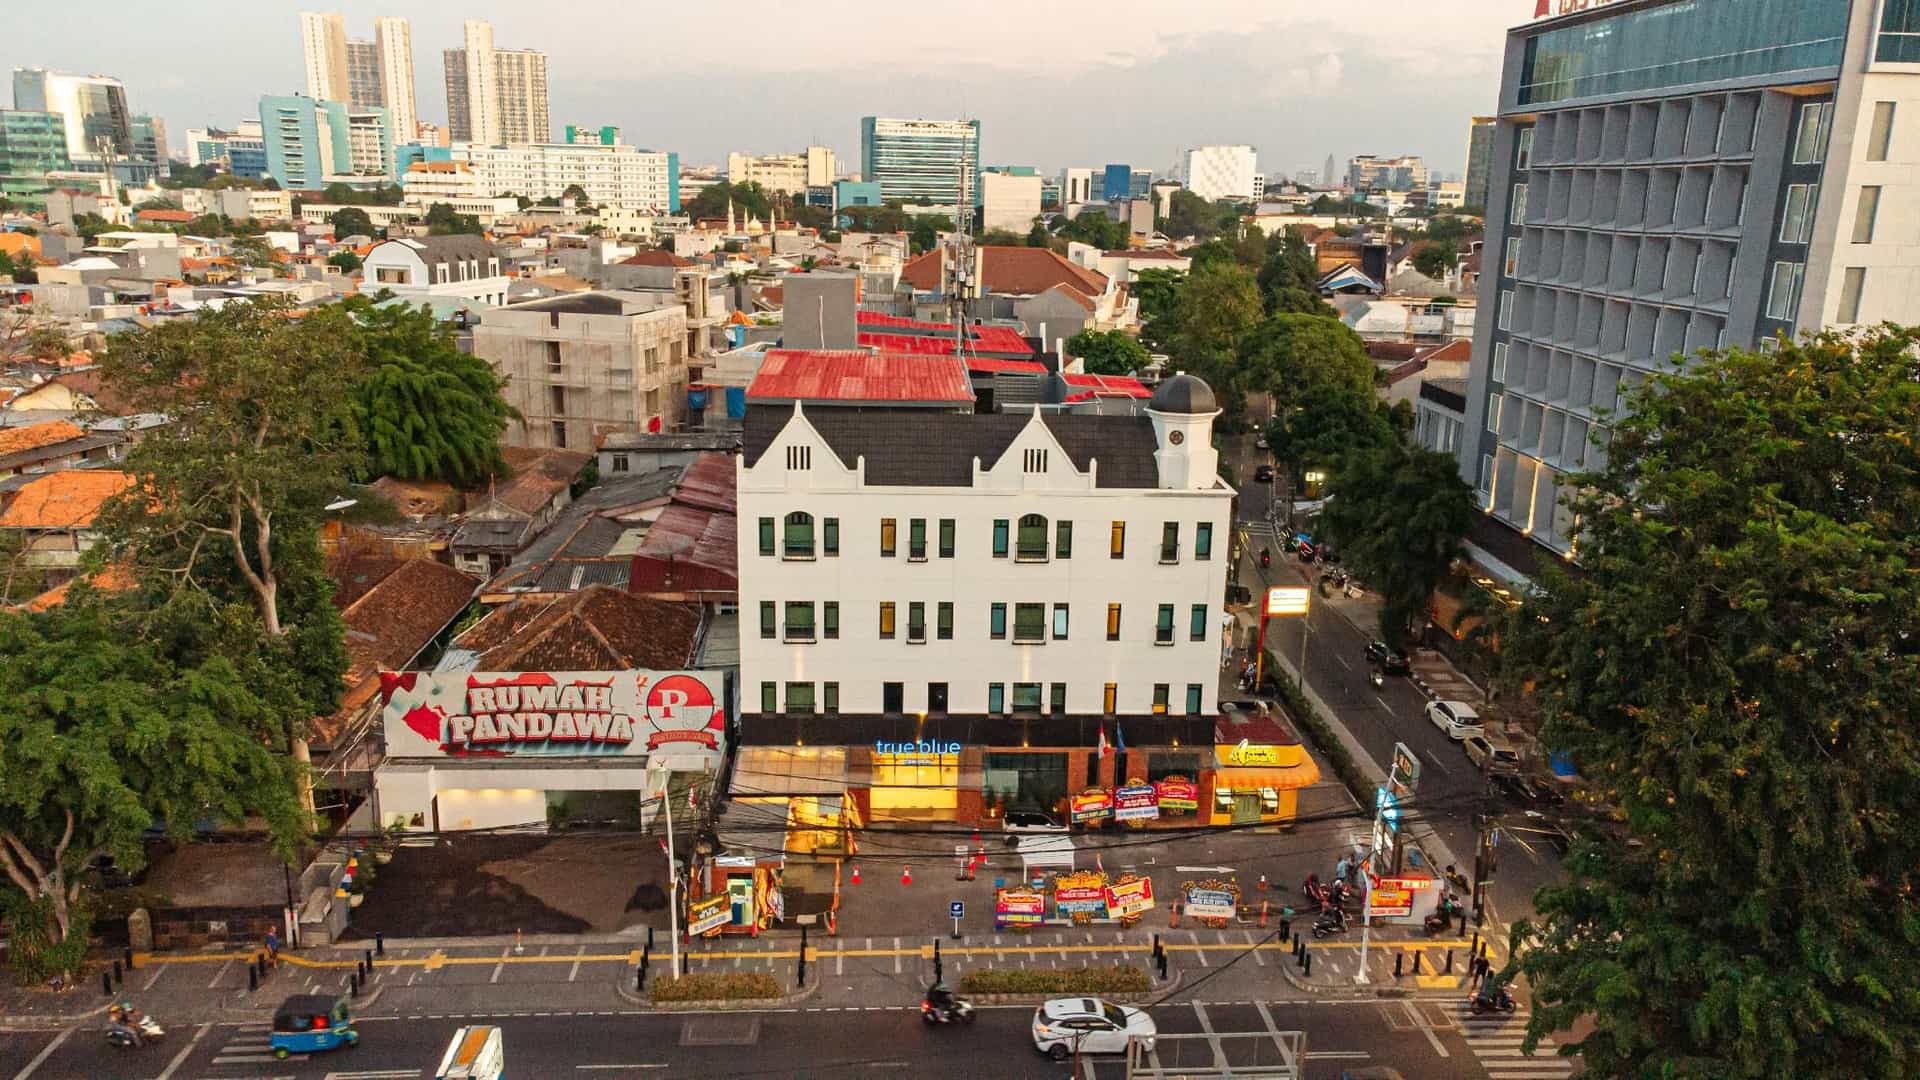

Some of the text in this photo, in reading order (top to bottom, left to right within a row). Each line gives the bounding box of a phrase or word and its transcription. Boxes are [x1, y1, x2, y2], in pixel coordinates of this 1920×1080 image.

[468, 685, 612, 712] RUMAH
[657, 689, 688, 718] P
[450, 713, 634, 744] PANDAWA
[876, 738, 961, 754] true blue
